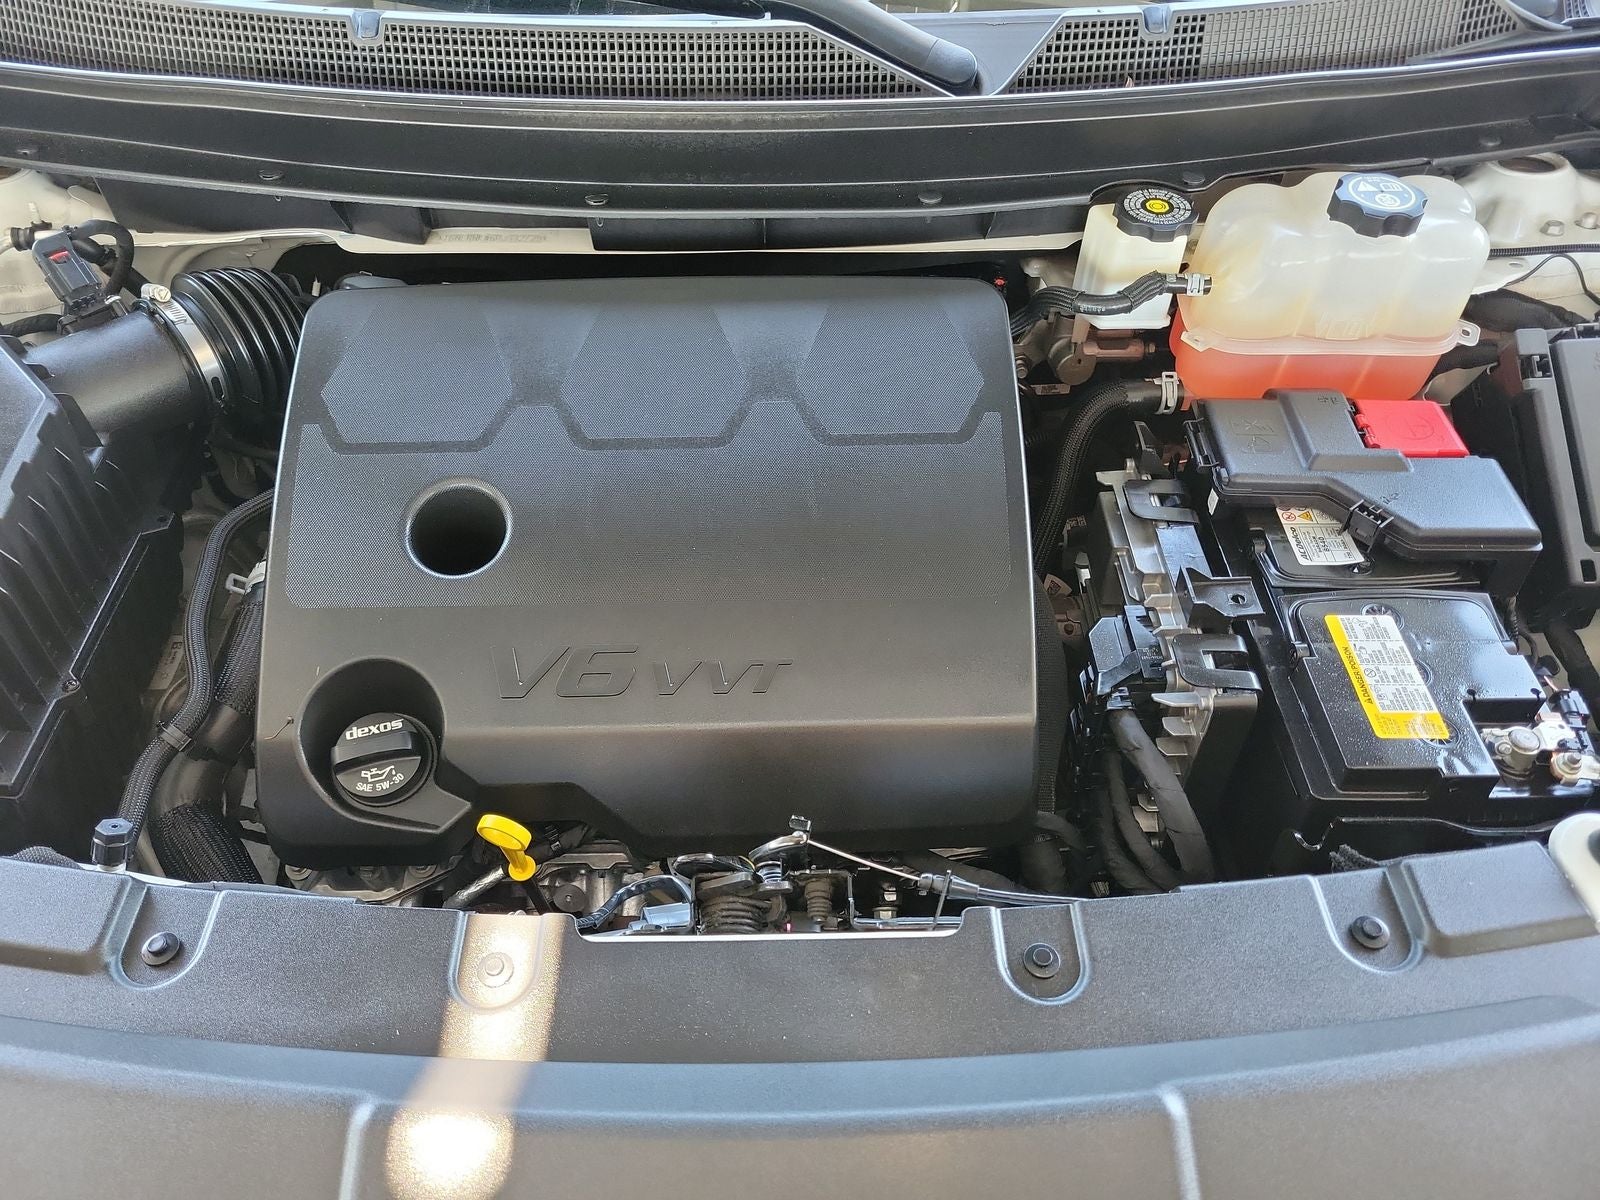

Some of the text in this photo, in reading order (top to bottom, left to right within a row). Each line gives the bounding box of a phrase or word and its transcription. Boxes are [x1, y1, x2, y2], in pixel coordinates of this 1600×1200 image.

[1289, 526, 1309, 561] ACDelco
[490, 645, 794, 699] V6 VVT
[345, 718, 405, 741] dexos
[355, 773, 405, 792] SAE 5W-30
